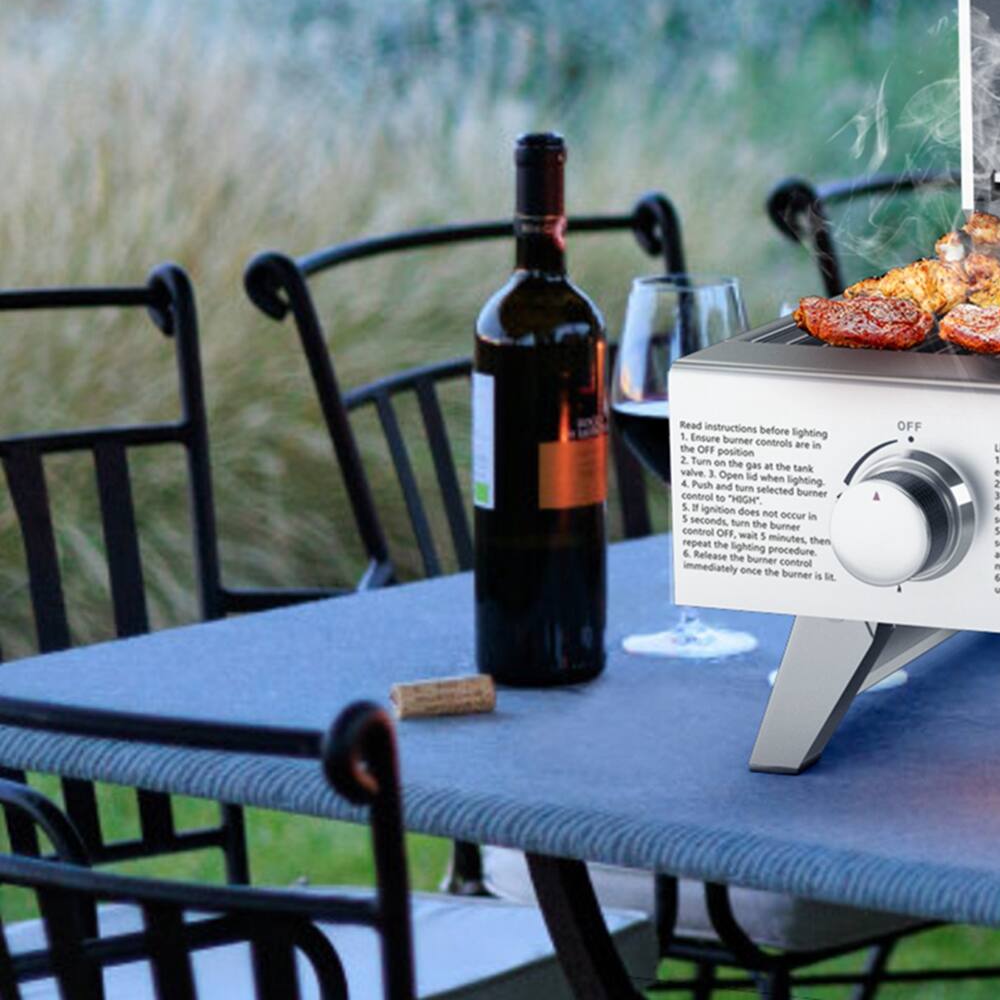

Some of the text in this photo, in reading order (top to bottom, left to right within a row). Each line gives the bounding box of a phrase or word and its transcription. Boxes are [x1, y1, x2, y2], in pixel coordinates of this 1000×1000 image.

[680, 421, 828, 440] Read instructions before lighting
[897, 420, 922, 431] OFF
[681, 433, 688, 441] 1.
[691, 433, 720, 443] Ensure
[723, 435, 753, 445] burner
[755, 439, 792, 448] controls
[812, 441, 821, 449] in
[680, 444, 754, 457] the OFF position
[681, 456, 689, 464] 2.
[691, 456, 712, 466] Turn
[728, 459, 743, 468] the
[746, 462, 761, 471] gas
[776, 463, 791, 471] the
[794, 465, 813, 473] tank
[681, 468, 825, 488] valve. 3. Open lid when lighting.
[681, 480, 827, 497] 4. Push and turn selected burner
[681, 493, 713, 501] control
[682, 503, 817, 520] 5. If ignition does not occur in
[683, 514, 800, 531] 5 seconds, turn the burner
[682, 528, 831, 545] control OFF, wait 5 minutes, then
[683, 540, 816, 556] repeat the lighting procedure.
[683, 549, 812, 567] 6. Release the burner control
[684, 561, 836, 581] immediately once the burner is lit.
